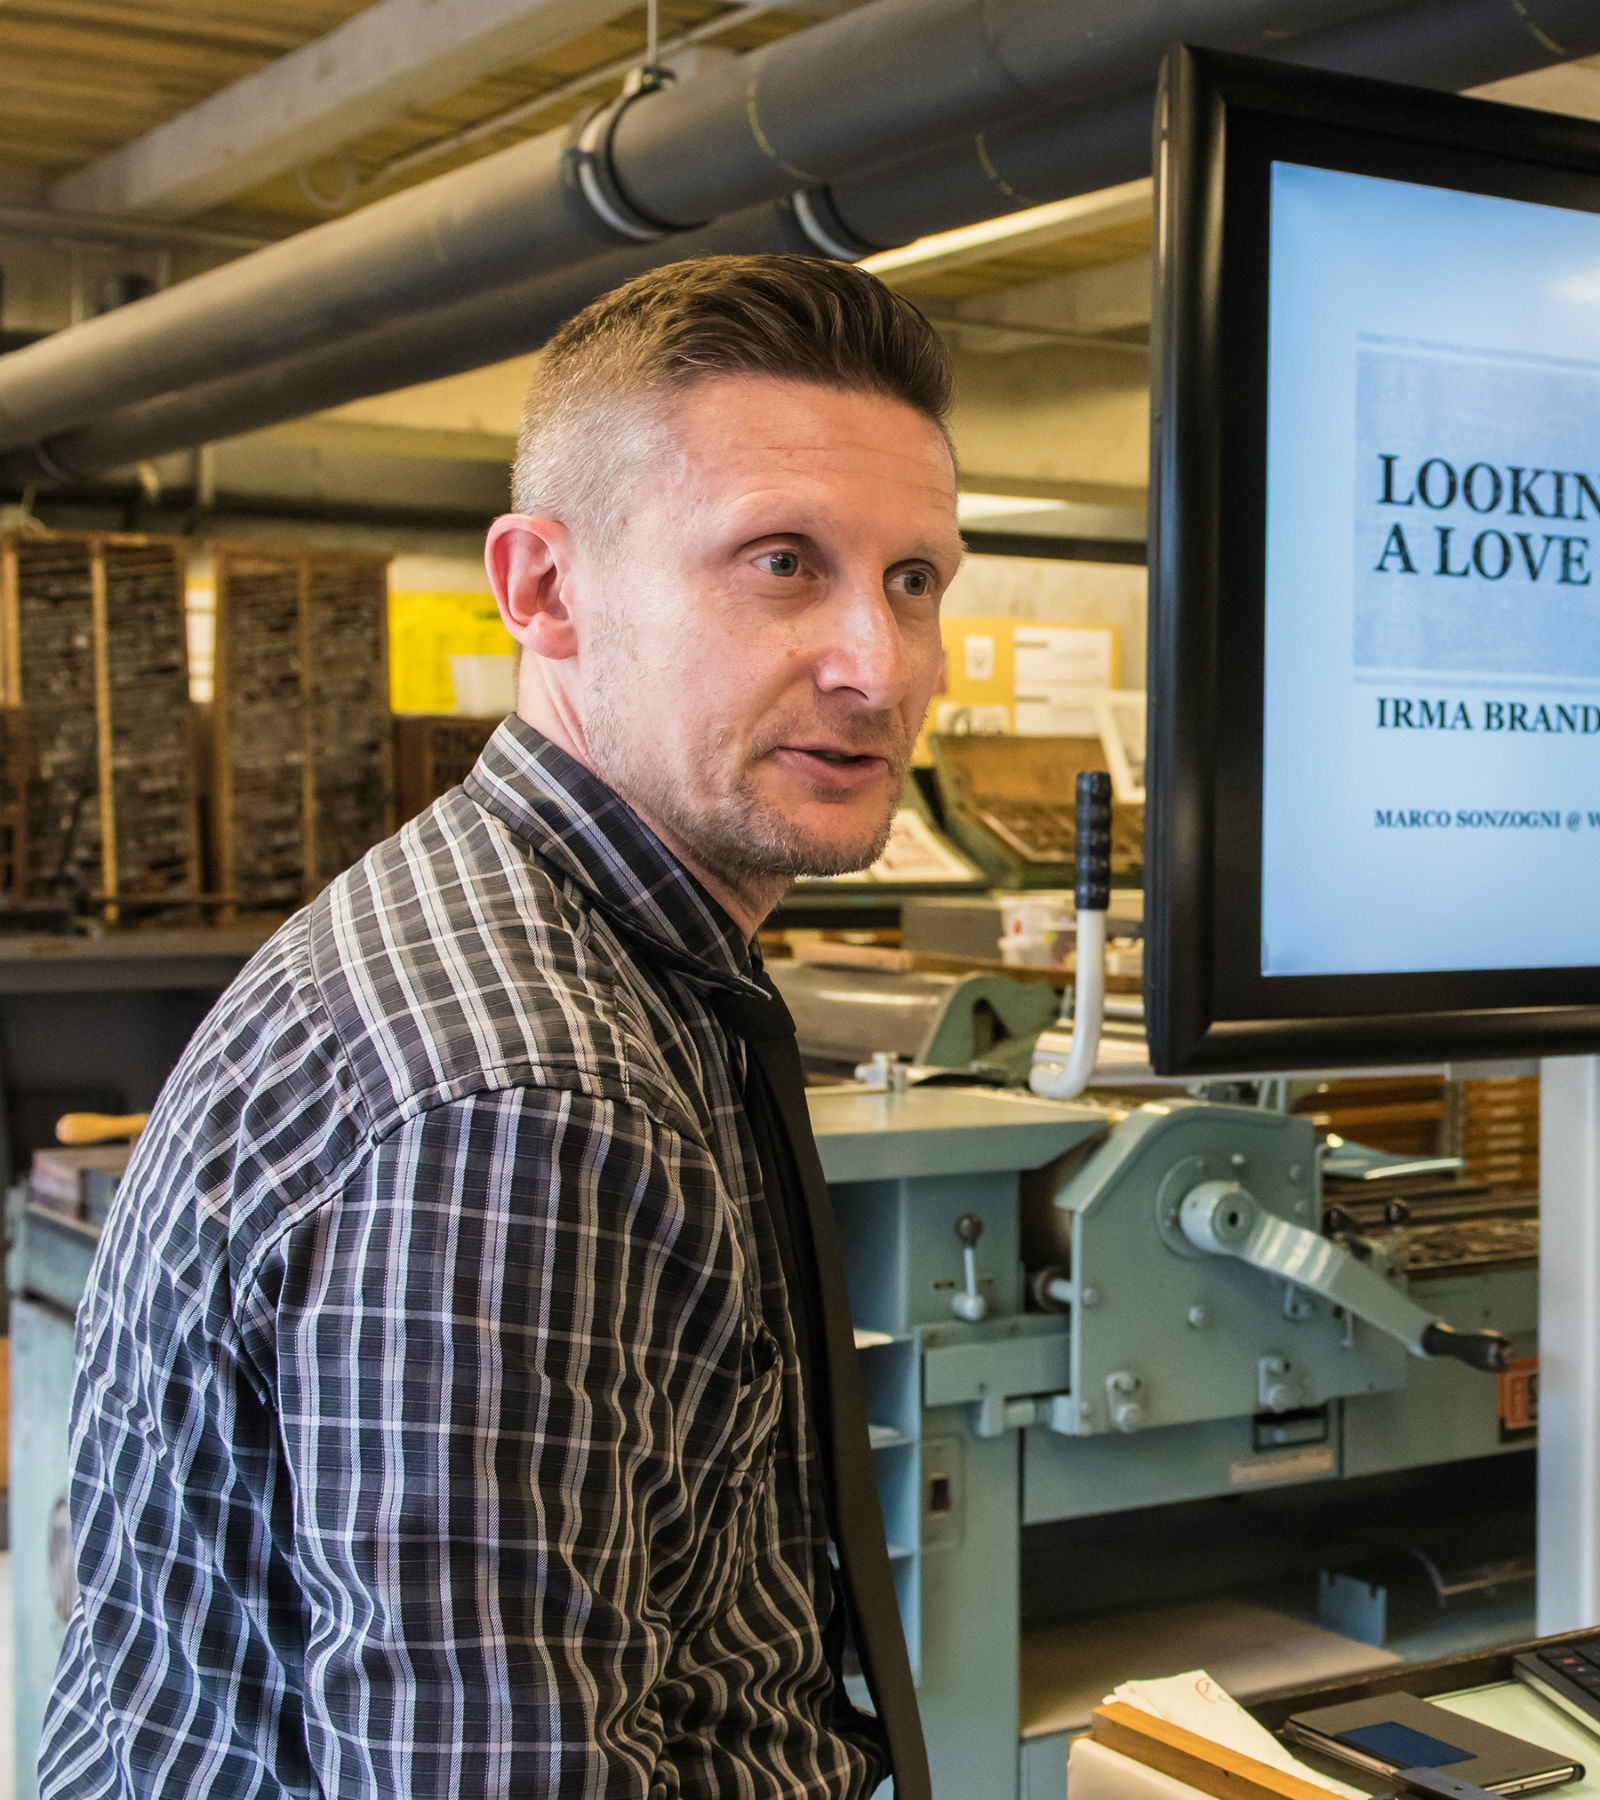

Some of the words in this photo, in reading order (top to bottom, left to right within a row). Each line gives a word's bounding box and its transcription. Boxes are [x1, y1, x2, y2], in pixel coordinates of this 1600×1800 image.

[1374, 522, 1418, 574] A
[1432, 525, 1592, 586] LOVE
[1377, 697, 1474, 731] IRMA
[1374, 808, 1450, 829] MARCO
[1454, 809, 1562, 830] SONZOGNI
[1565, 811, 1582, 833] @
